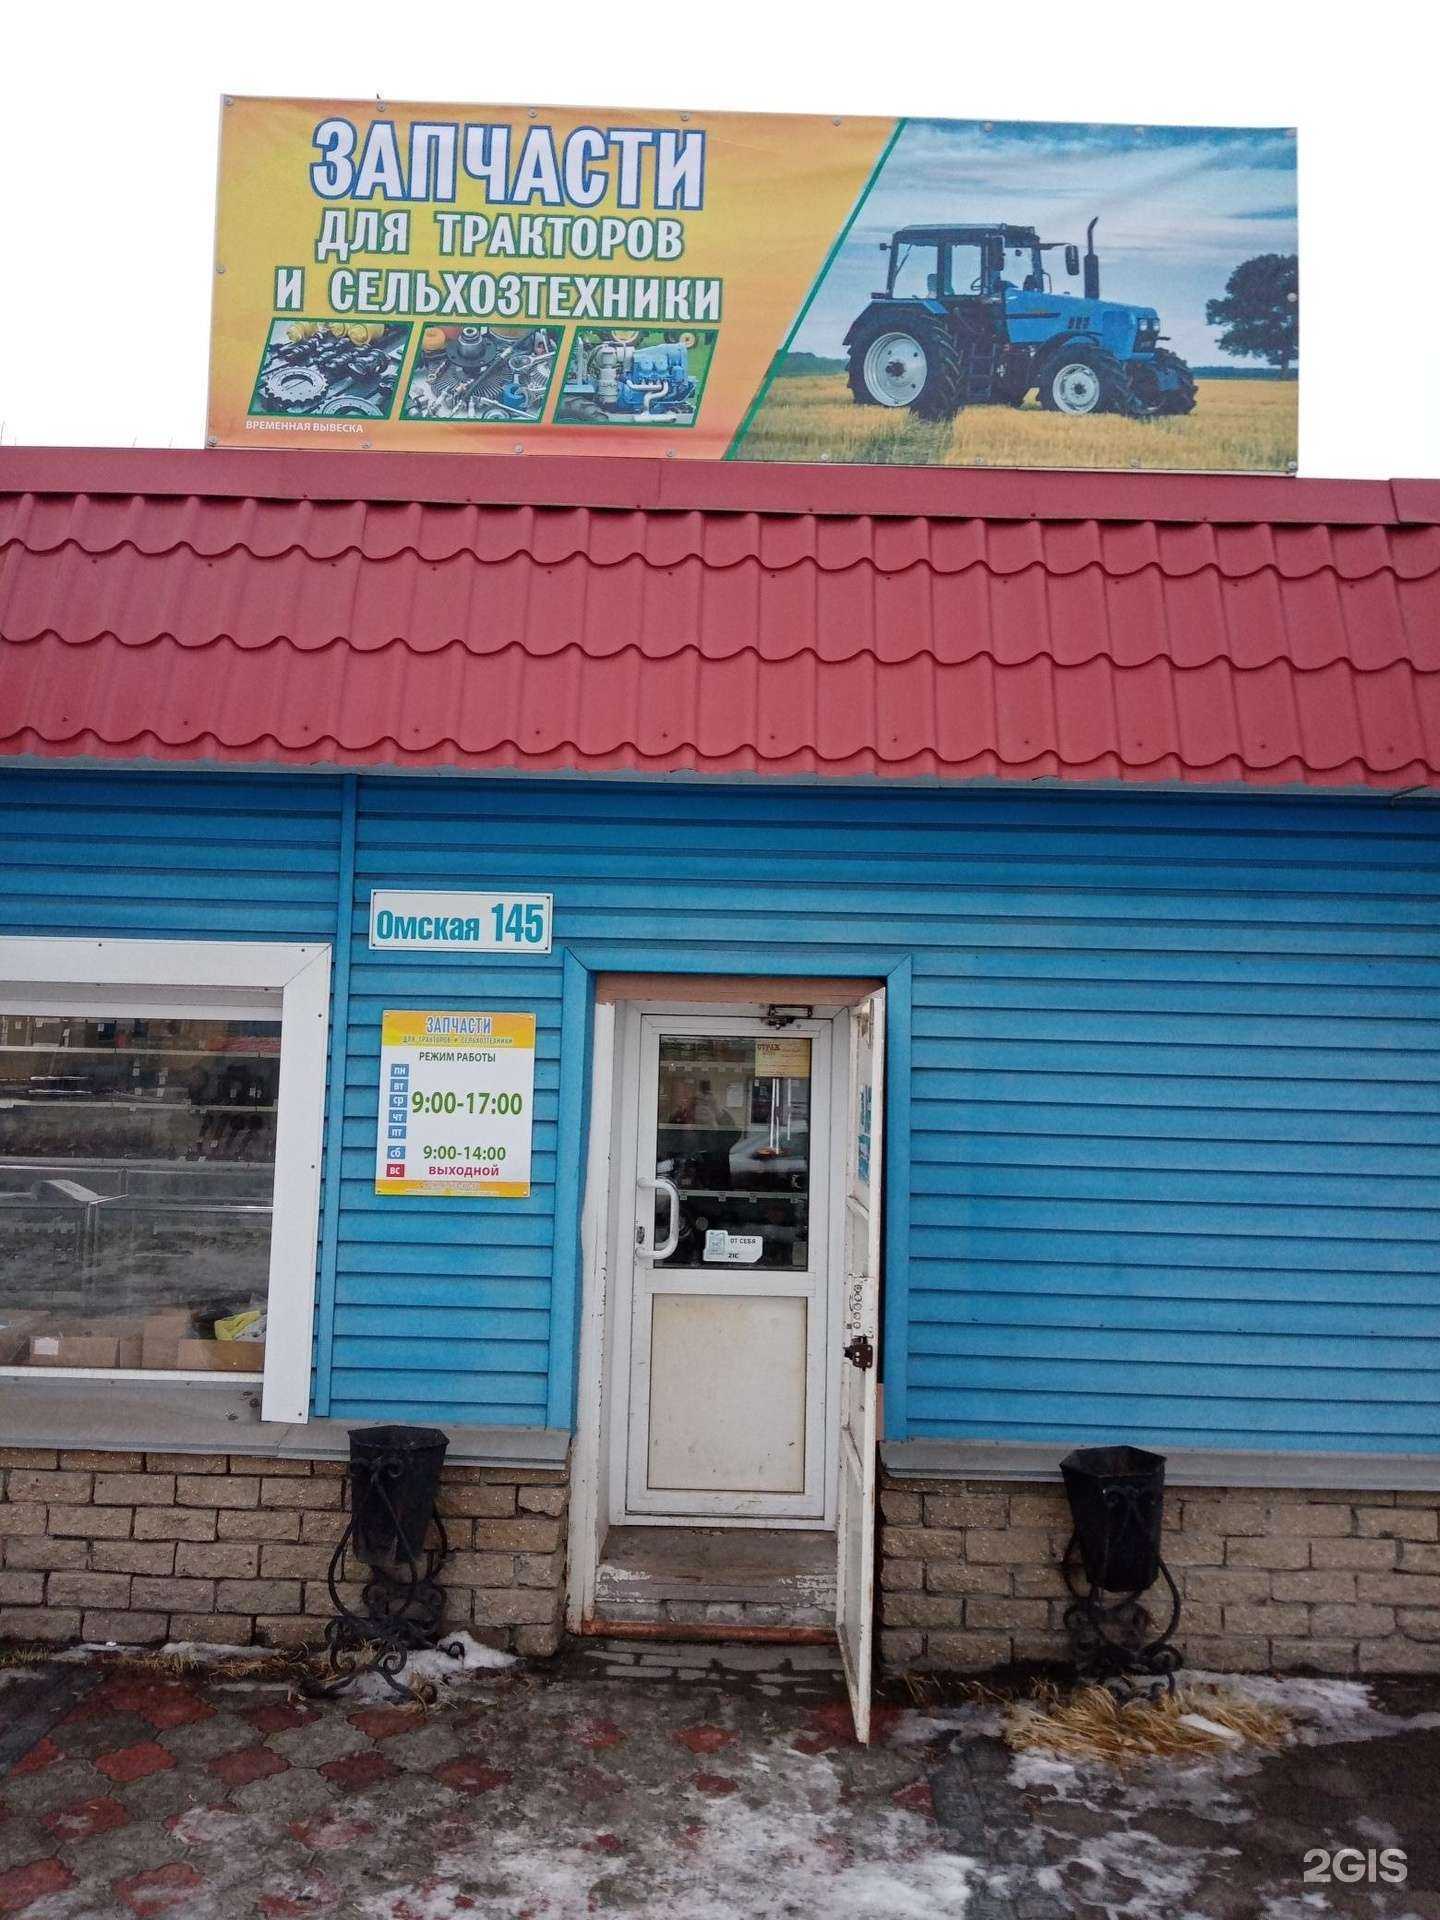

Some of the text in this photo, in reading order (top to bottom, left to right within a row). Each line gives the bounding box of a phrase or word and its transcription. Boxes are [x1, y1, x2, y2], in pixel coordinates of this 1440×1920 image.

[310, 117, 706, 210] ЗАПЧАСТИ
[316, 207, 686, 263] ДЛЯ ТРАКТОРОВ
[274, 265, 723, 323] И СЕЛЬХОЗТЕХНИКИ
[246, 420, 364, 433] ВРЕМЕННАЯ ВЫВЕСКА
[376, 903, 544, 943] Омская 145
[426, 1016, 492, 1034] ЗАПЧАСТИ
[419, 1051, 496, 1063] РЕЖИМ РАБОТЫ
[411, 1091, 523, 1115] 9:00-17:00
[423, 1145, 506, 1161] 9:00-14:00
